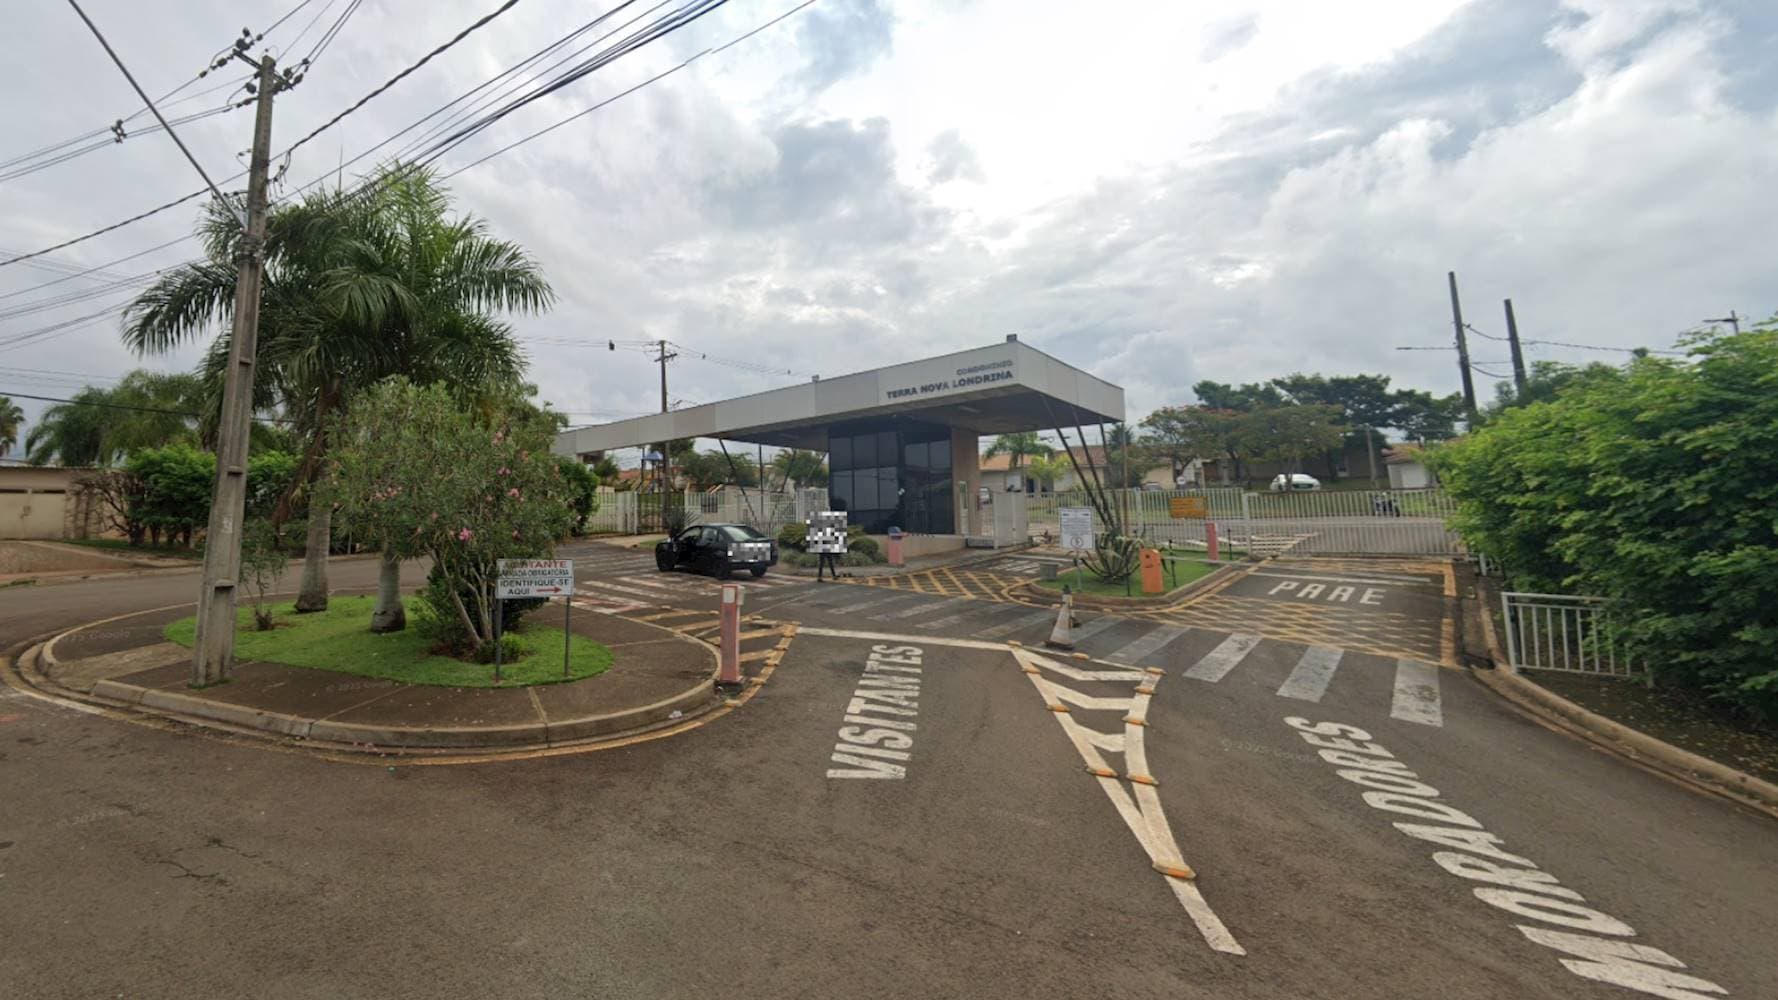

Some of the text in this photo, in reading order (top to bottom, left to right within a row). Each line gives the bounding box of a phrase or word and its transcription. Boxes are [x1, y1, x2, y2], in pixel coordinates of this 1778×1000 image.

[887, 370, 1013, 399] TERRA NOVA LONDRINA
[1268, 580, 1387, 606] PARE
[826, 644, 923, 780] VISITANTES
[1284, 716, 1729, 1000] MORADORES
